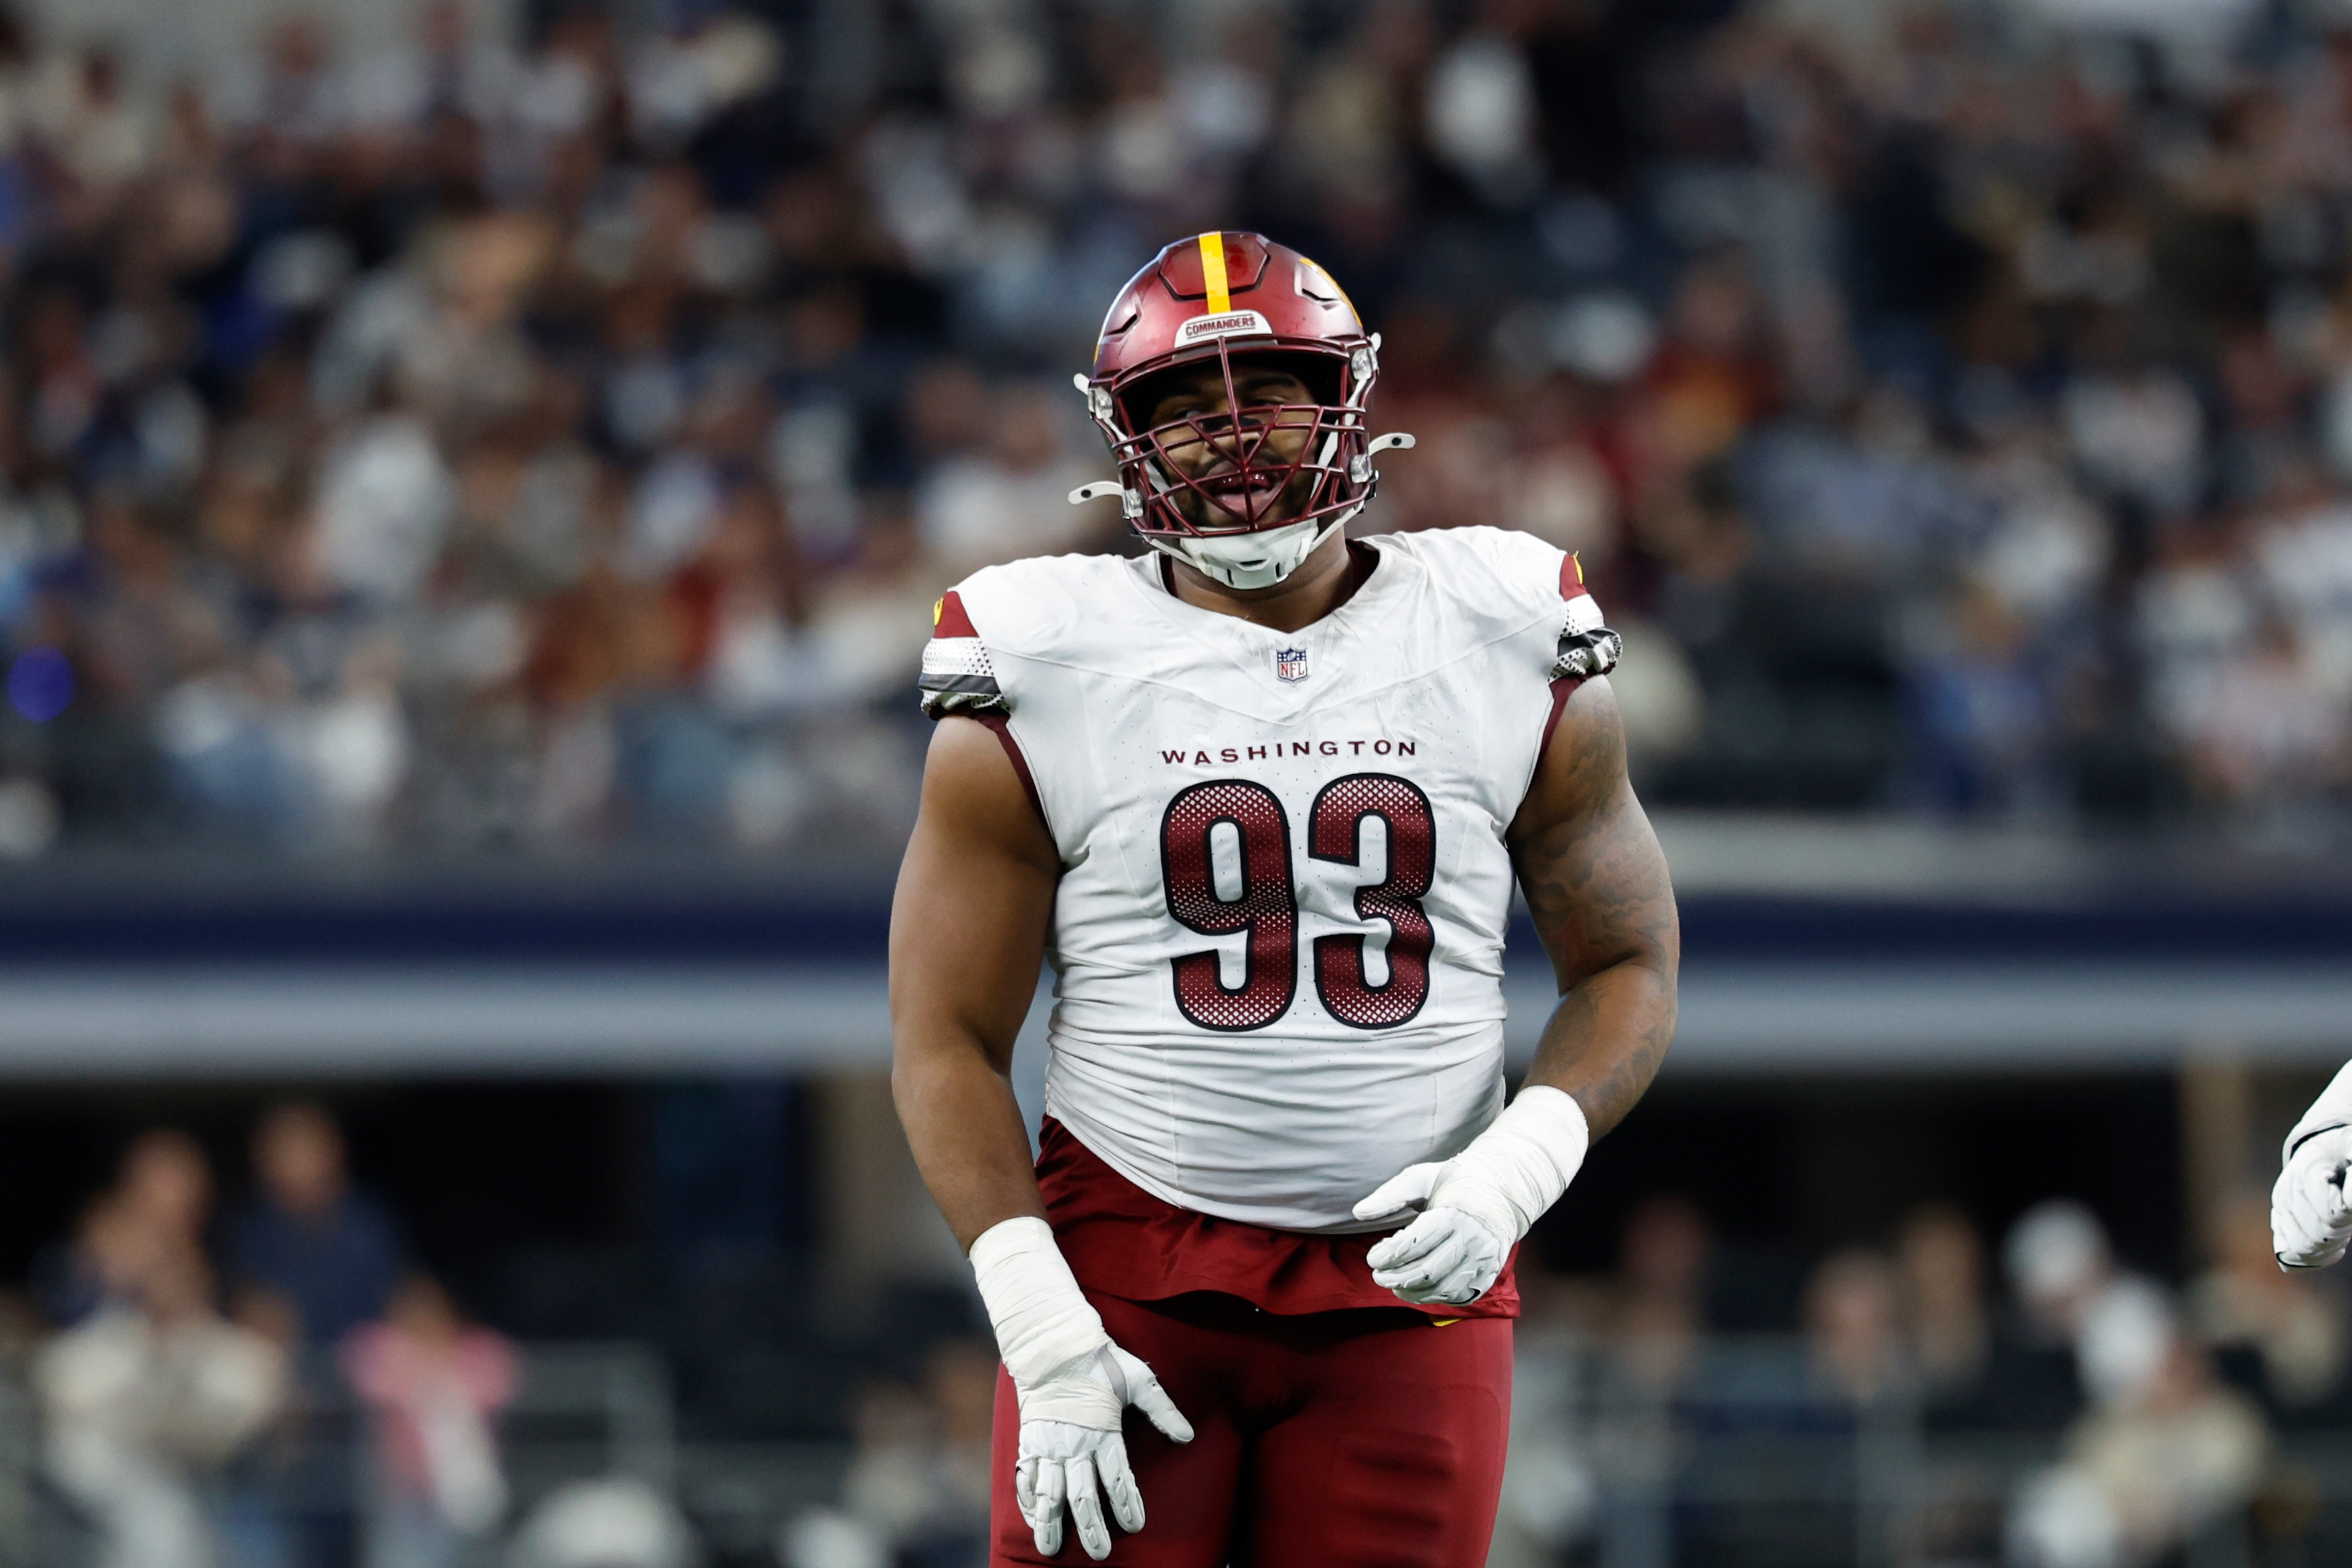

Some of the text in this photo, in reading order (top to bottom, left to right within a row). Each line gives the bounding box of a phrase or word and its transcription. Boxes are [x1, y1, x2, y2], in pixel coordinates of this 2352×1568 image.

[1186, 317, 1255, 336] COMMANDERS
[1280, 662, 1304, 678] NFL
[1161, 740, 1416, 765] WASHINGTON
[1160, 772, 1436, 1032] 93
